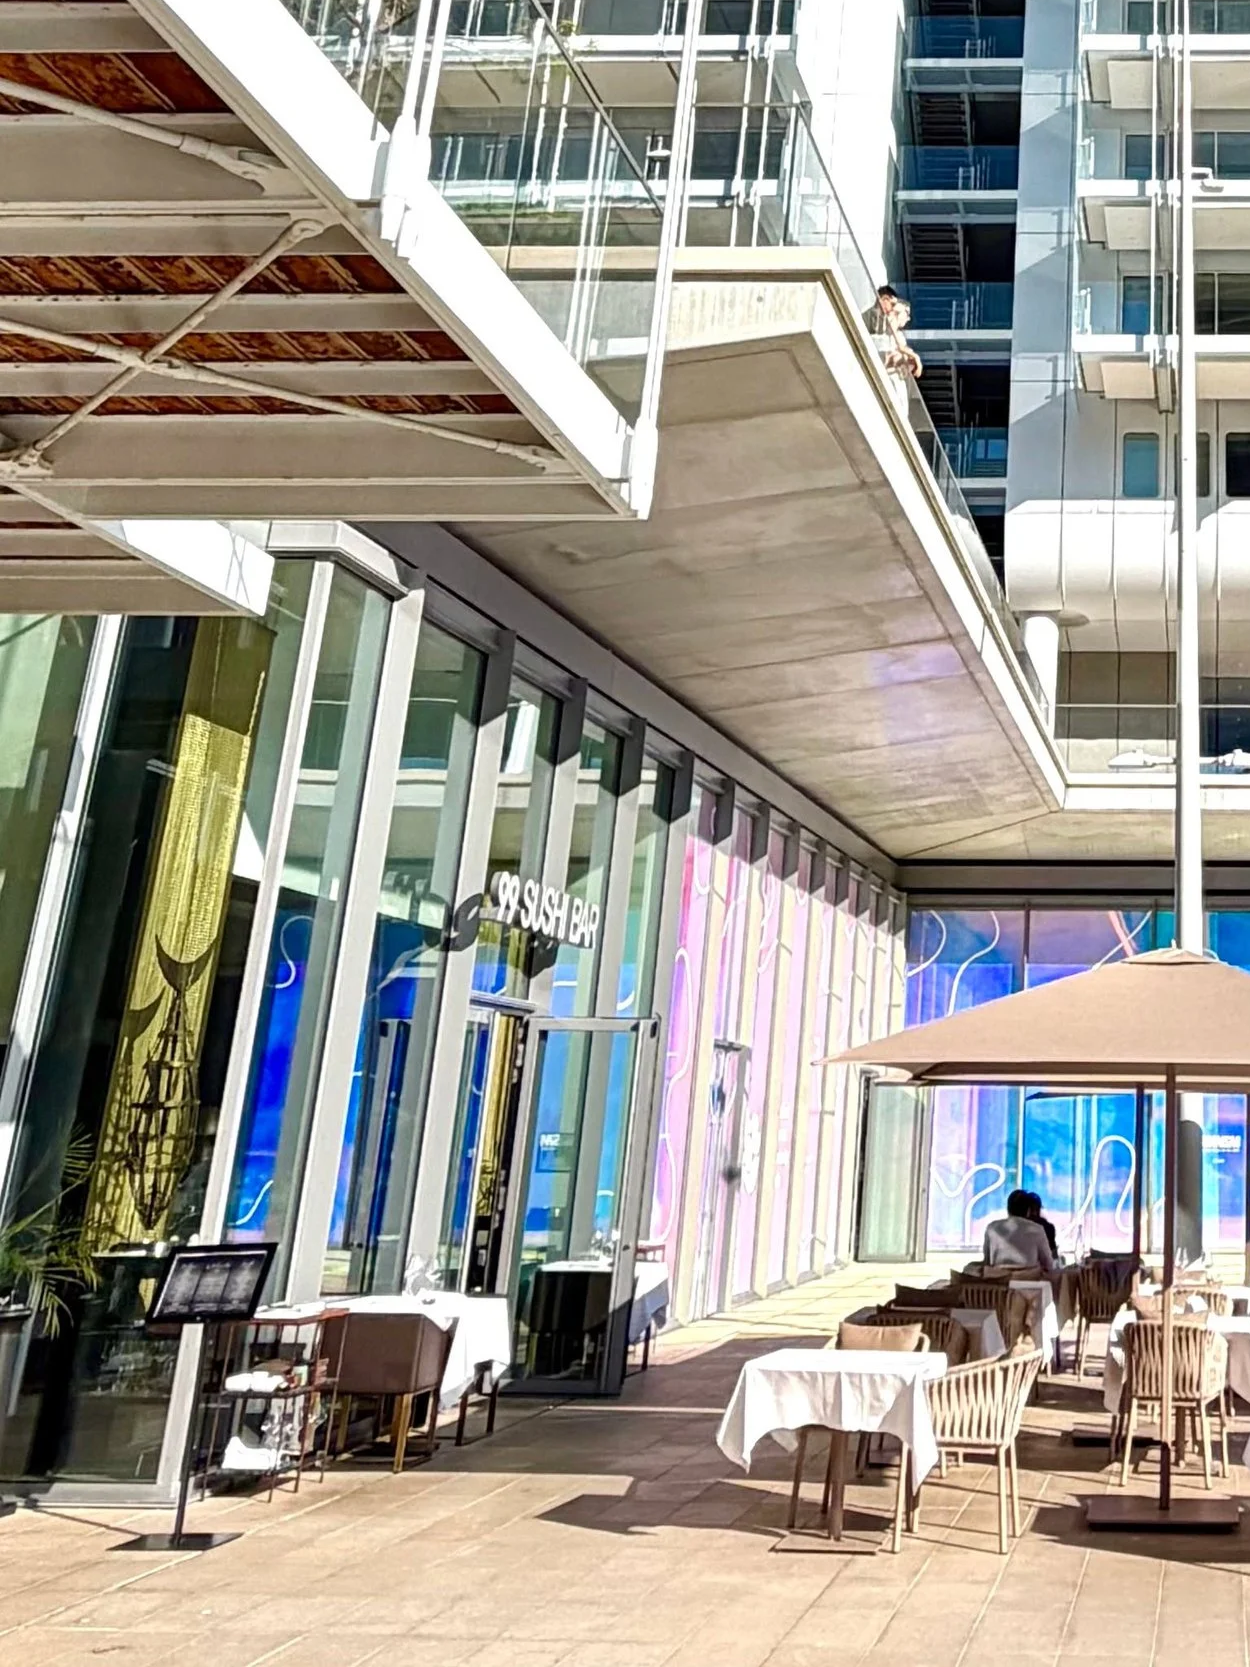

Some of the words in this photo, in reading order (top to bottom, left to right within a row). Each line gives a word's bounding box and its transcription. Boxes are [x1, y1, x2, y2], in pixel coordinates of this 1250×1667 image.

[497, 871, 520, 924] 99
[521, 879, 569, 939] SUSHI
[568, 897, 599, 949] BAR
